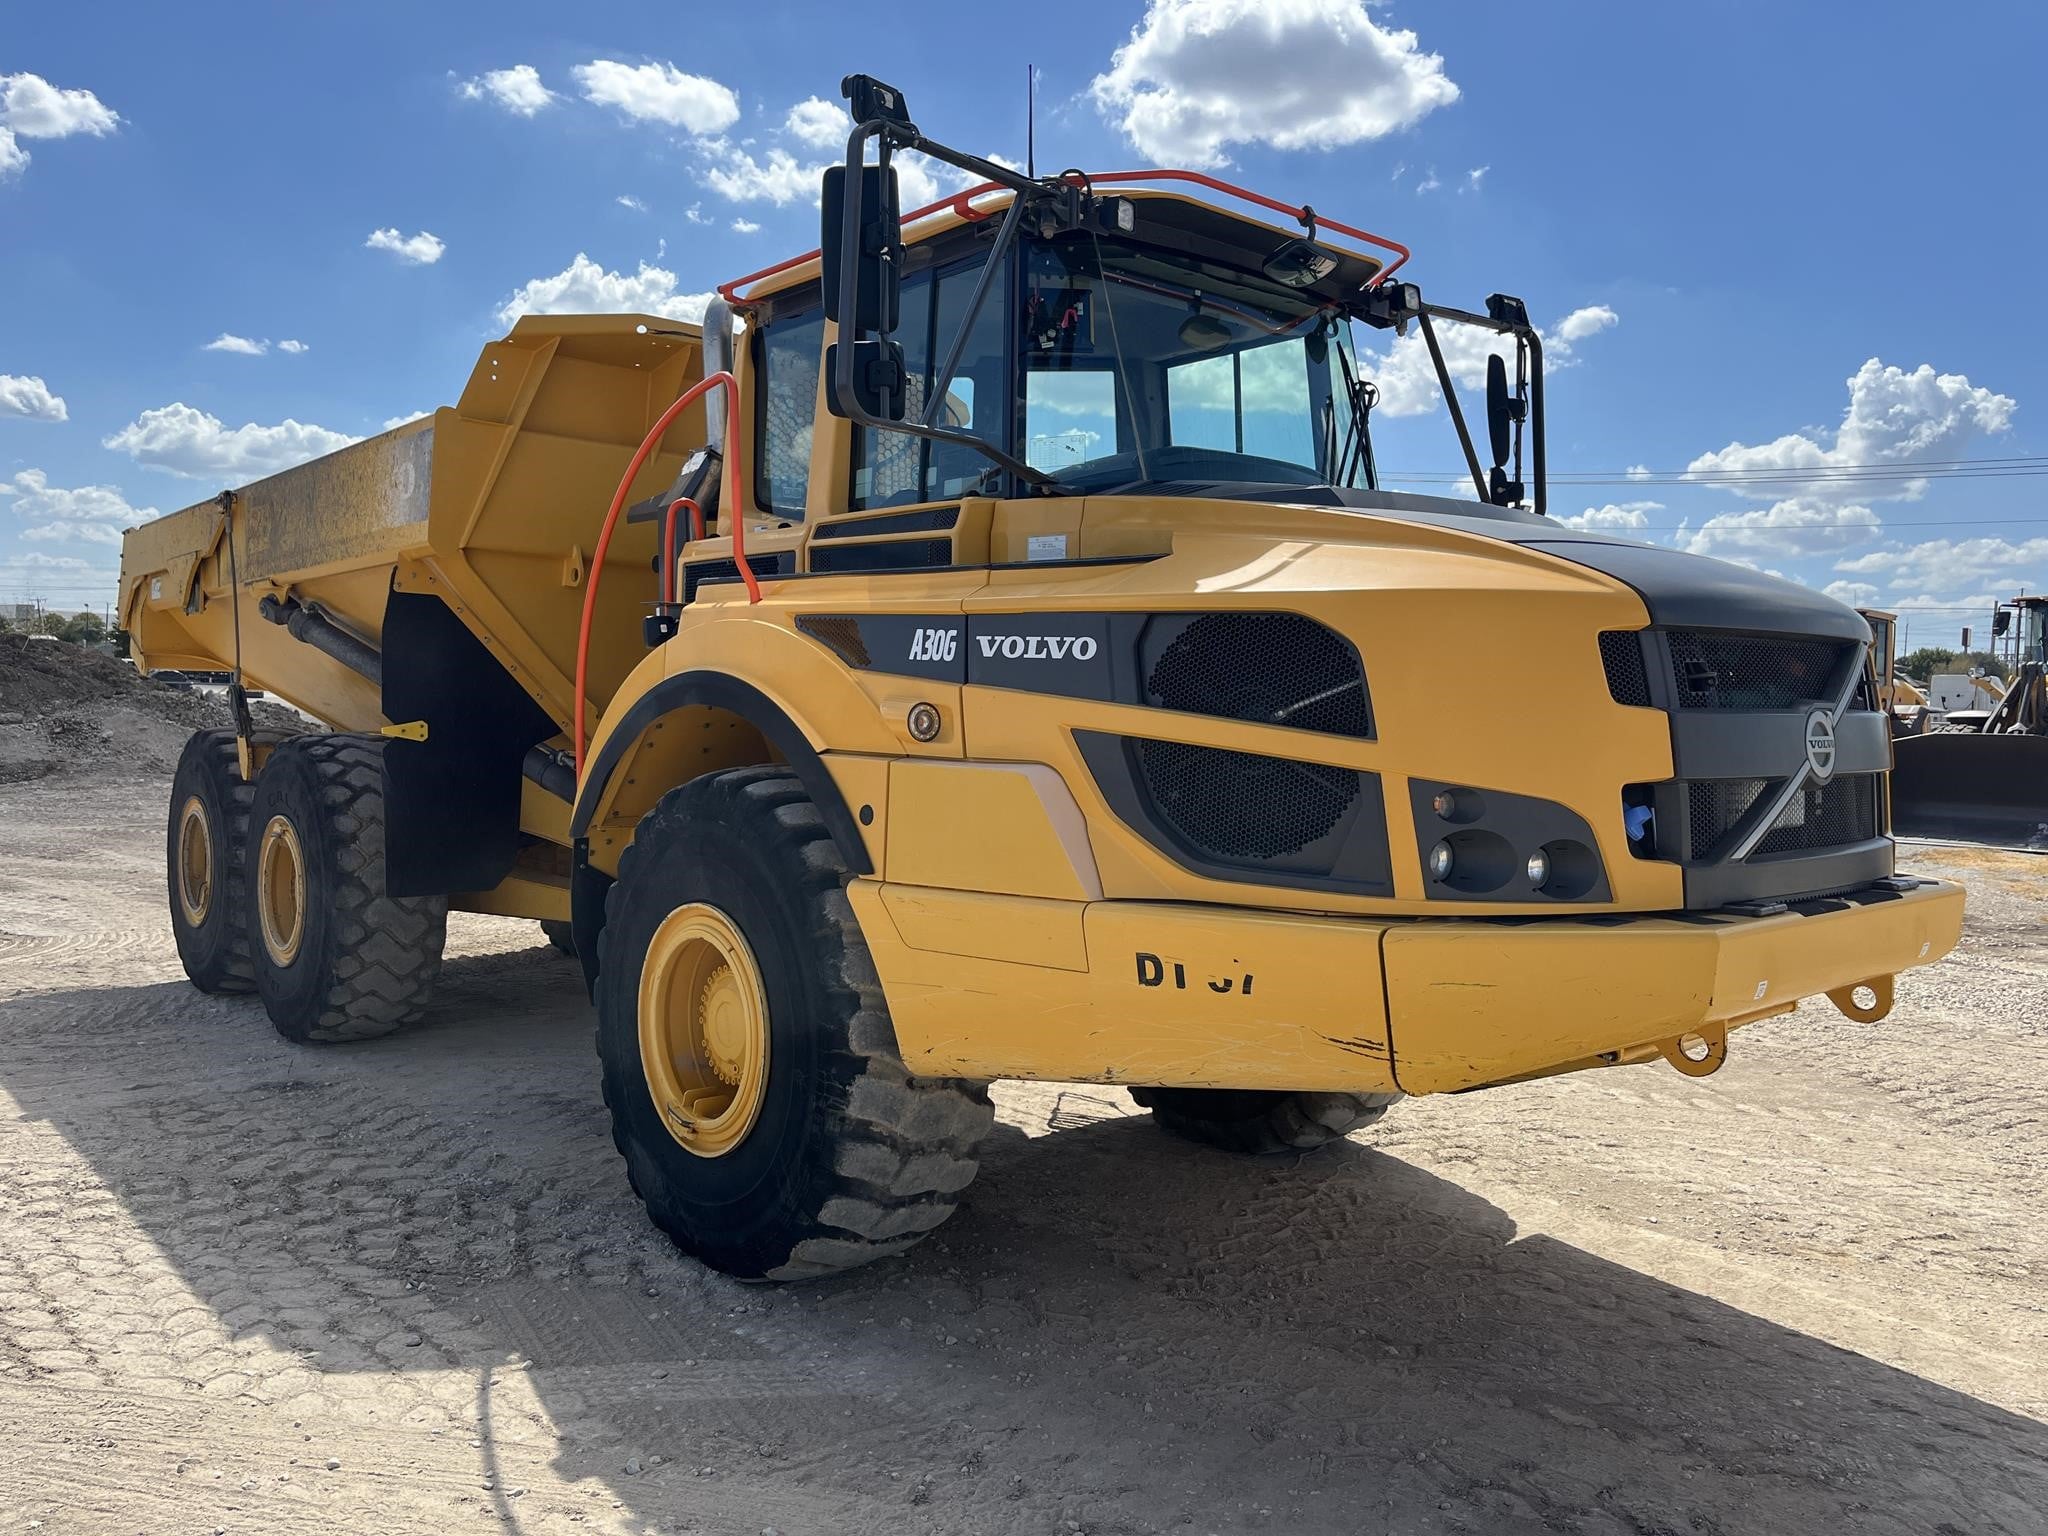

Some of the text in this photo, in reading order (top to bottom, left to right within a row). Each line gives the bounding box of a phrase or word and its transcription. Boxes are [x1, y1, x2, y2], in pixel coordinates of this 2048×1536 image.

[909, 628, 958, 662] A30G
[976, 635, 1098, 661] VOLVO
[1808, 739, 1834, 749] VOLV
